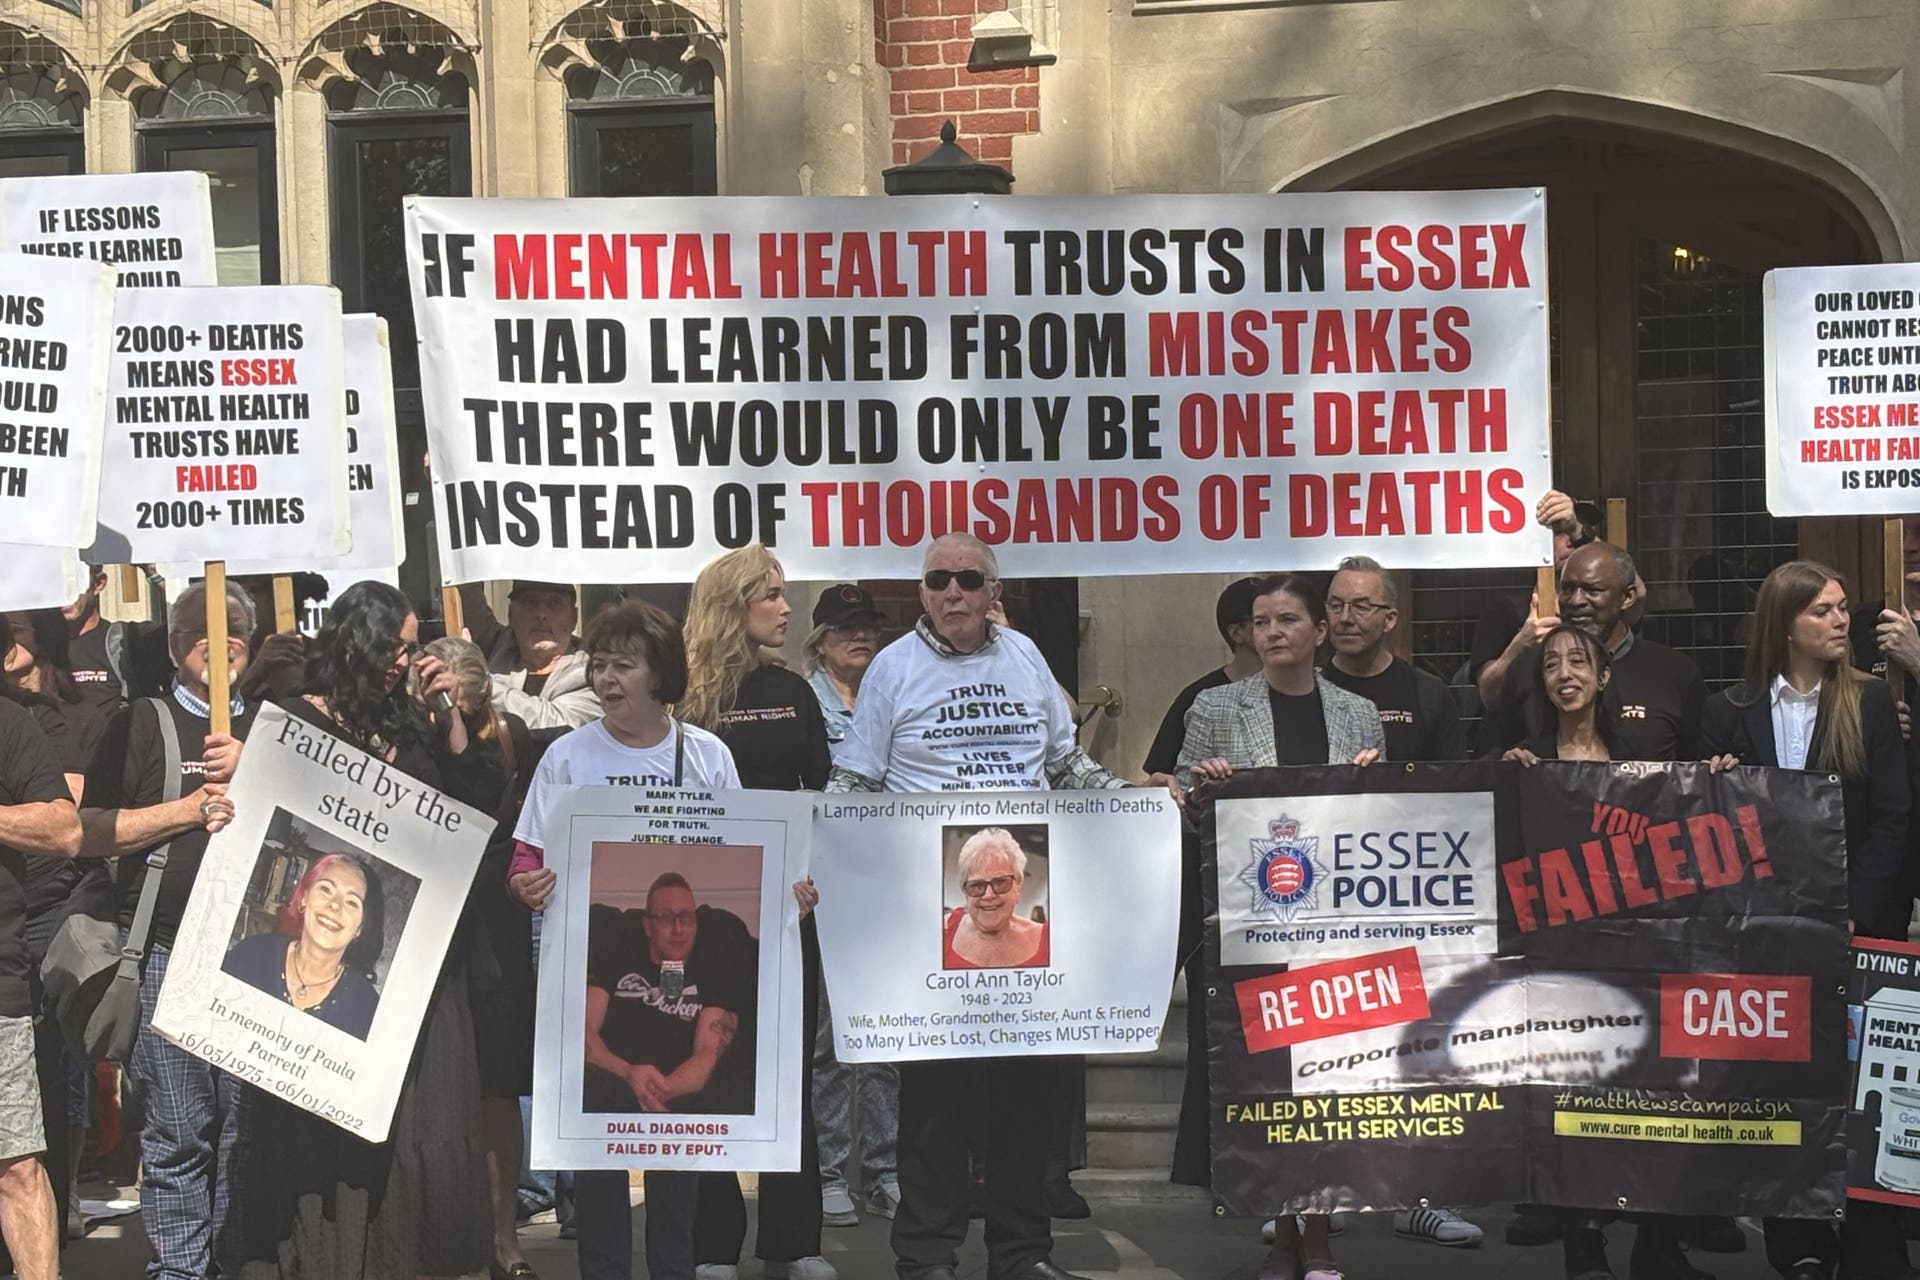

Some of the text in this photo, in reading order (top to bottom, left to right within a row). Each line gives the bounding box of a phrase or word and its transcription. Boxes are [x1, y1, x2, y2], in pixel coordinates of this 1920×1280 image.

[40, 205, 161, 233] IF LESSONS
[90, 238, 182, 262] LEARNED
[421, 224, 1530, 299] IF MENTAL HEALTH TRUSTS IN ESSEX
[0, 294, 44, 327] NS
[1815, 290, 1914, 312] OUR LOVED
[116, 324, 304, 353] 2000+ DEATHS
[1816, 318, 1920, 340] CANNOT RE
[495, 306, 1472, 384] HAD LEARNED FROM MISTAKES
[1817, 347, 1873, 367] PEACE
[127, 358, 297, 388] MEANS ESSEX
[1828, 373, 1920, 394] TRUTH AB
[0, 381, 58, 413] ULD
[116, 394, 309, 423] MENTAL HEALTH
[463, 388, 1507, 468] THERE WOULD ONLY BE ONE DEATH
[1814, 404, 1881, 429] ESSEX
[0, 423, 69, 457] BEEN
[130, 429, 299, 459] TRUSTS HAVE
[1801, 438, 1881, 462] HEALTH
[176, 464, 257, 492] FAILED
[1842, 470, 1860, 489] IS
[136, 498, 304, 528] 2000+ TIMES
[445, 467, 1526, 550] INSTEAD OF THOUSANDS OF DEATHS
[947, 683, 1006, 700] TRUTH
[936, 702, 1028, 724] JUSTICE
[922, 724, 1039, 740] ACCOUNTABILITY
[956, 762, 1025, 777] MATTER
[963, 751, 1011, 762] LIVES
[276, 715, 461, 832] Failed by the
[605, 775, 673, 787] TRUTH
[941, 780, 975, 791] MINE,
[977, 779, 1020, 789] YOURS,
[646, 791, 715, 801] MARK TYLER.
[824, 796, 1163, 822] Lampard Inquiry into Mental Health Deaths
[318, 793, 389, 843] state
[634, 805, 725, 816] WE ARE FIGHTING
[1591, 801, 1649, 845] YOU
[649, 820, 669, 829] FOR
[1334, 831, 1472, 871] ESSEX
[1502, 804, 1774, 933] FAILED!
[1333, 874, 1474, 909] POLICE
[1246, 922, 1475, 943] Protecting and serving Essex
[1856, 952, 1909, 975] DYING
[926, 969, 1065, 991] Carol Ann Taylor
[961, 993, 990, 1006] 1948
[1002, 992, 1033, 1005] 2023
[1258, 965, 1402, 1032] RE OPEN
[848, 1005, 1151, 1030] Wife, Mother, Grandmother, Sister, Aunt & Friend
[1683, 988, 1789, 1038] CASE
[208, 997, 356, 1081] In memory of Paula
[843, 1025, 1160, 1051] Too Many Lives Lost, Changes MUST Happen
[1871, 1018, 1920, 1036] MENT
[1298, 1012, 1644, 1078] Corporate manslaughter
[247, 1041, 309, 1080] Parretti
[178, 1032, 264, 1083] 16/05/1975
[275, 1080, 364, 1130] 06/01/2022
[1226, 1092, 1504, 1123] FAILED BY ESSEX MENTAL
[1554, 1090, 1792, 1121] #matthewscampaign
[607, 1122, 729, 1135] DUAL DIAGNOSIS
[1267, 1117, 1464, 1143] HEALTH SERVICES
[1580, 1121, 1774, 1142] www.cure mental health .co.uk
[1893, 1133, 1920, 1149] WHI
[607, 1143, 728, 1156] FAILED BY EPUT.
